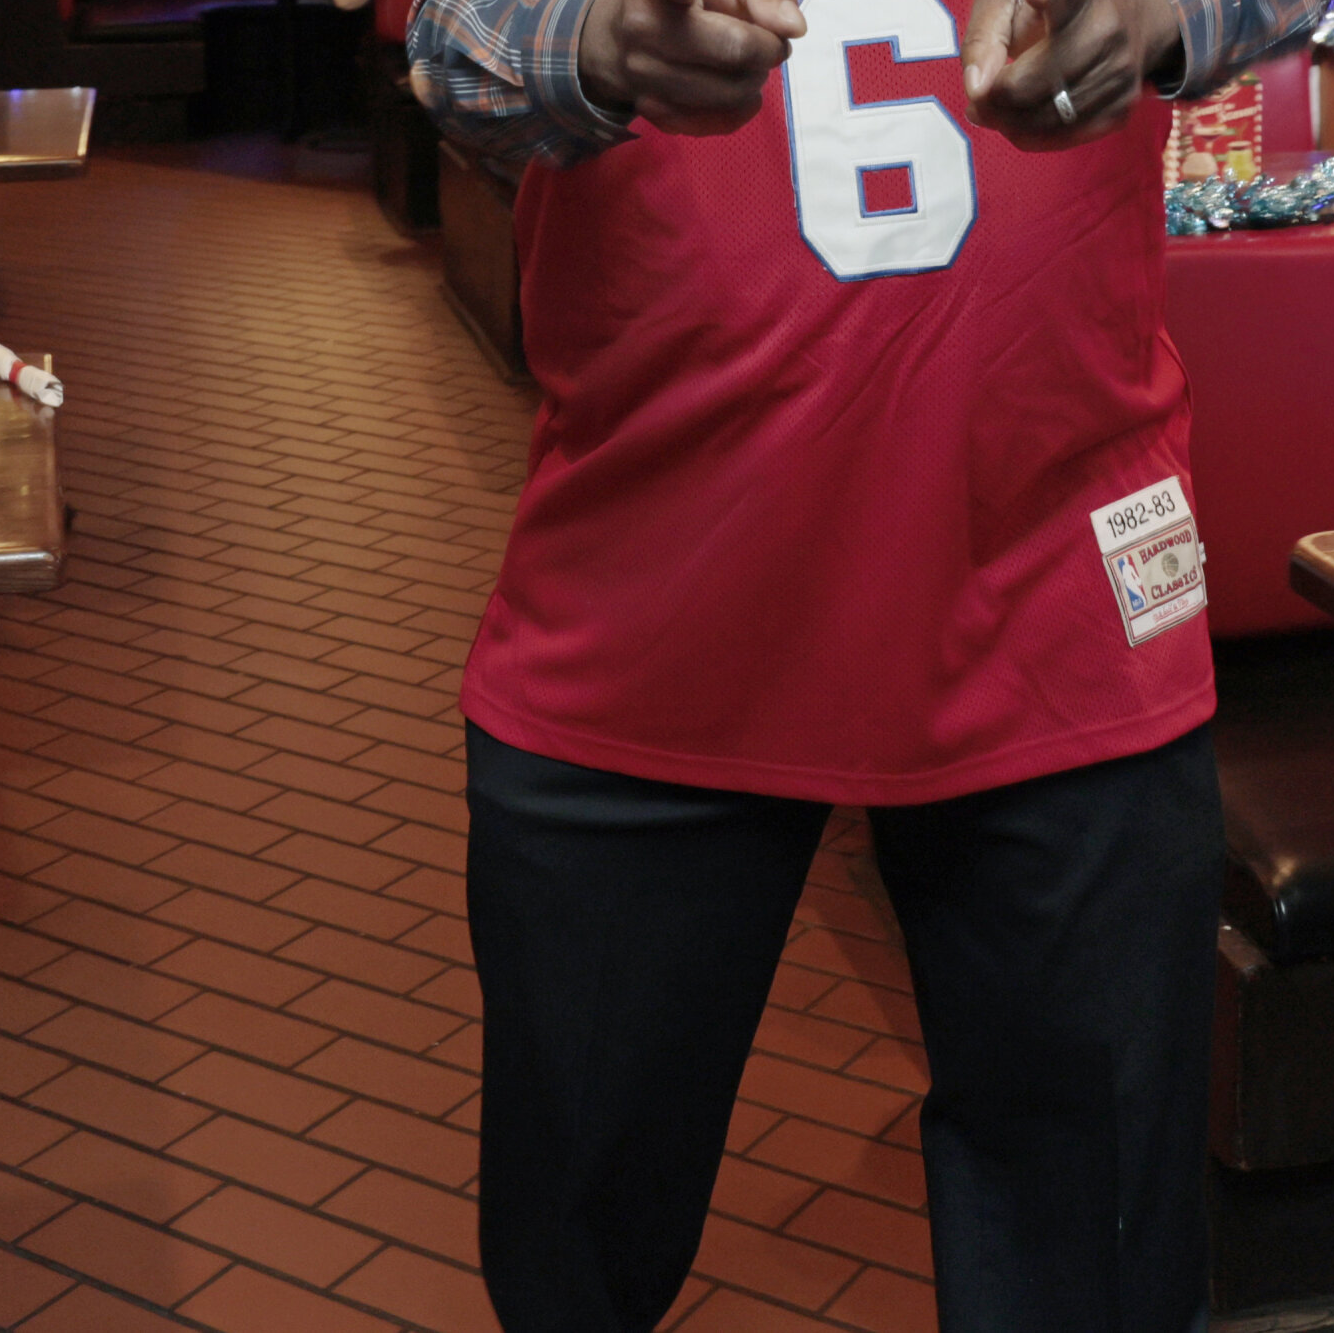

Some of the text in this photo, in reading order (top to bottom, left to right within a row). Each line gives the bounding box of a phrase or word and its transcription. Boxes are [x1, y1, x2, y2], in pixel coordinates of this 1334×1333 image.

[1107, 490, 1176, 538] 1982-83
[1139, 529, 1193, 565] HARDWOOD
[1150, 568, 1198, 600] CLASSICS
